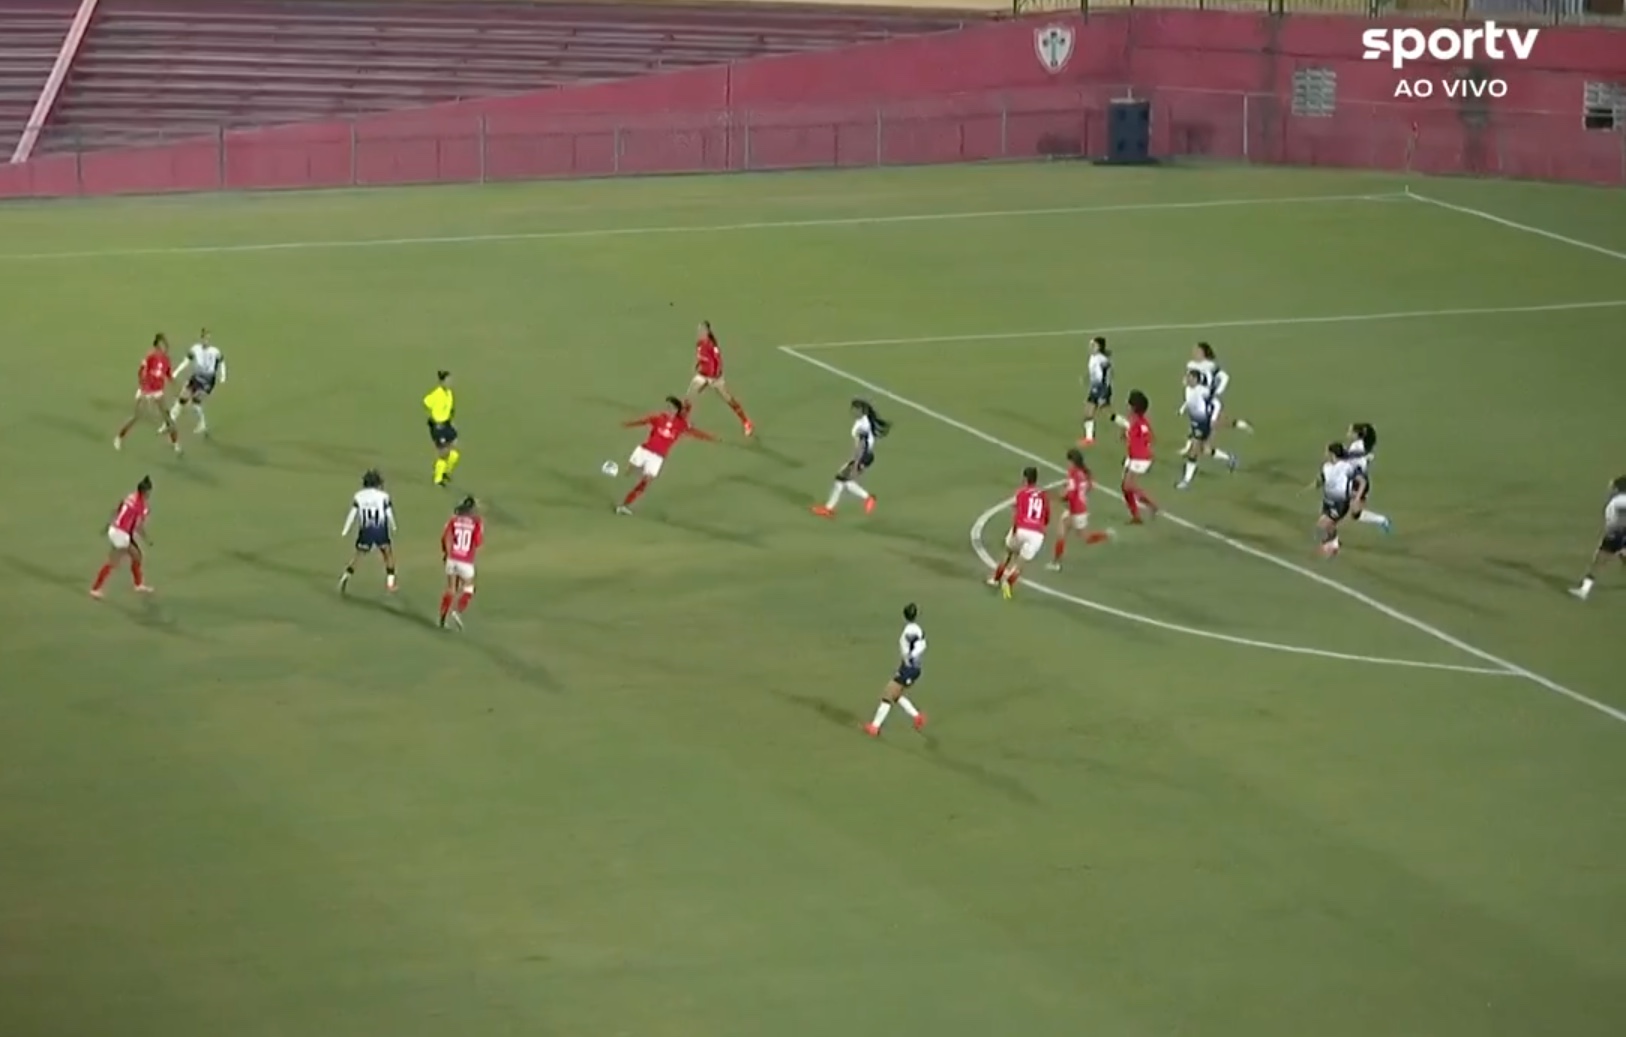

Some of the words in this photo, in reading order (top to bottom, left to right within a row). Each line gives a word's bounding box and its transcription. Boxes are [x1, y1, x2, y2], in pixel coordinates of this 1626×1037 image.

[362, 508, 379, 528] 14
[1027, 498, 1043, 519] 19
[453, 529, 472, 551] 30
